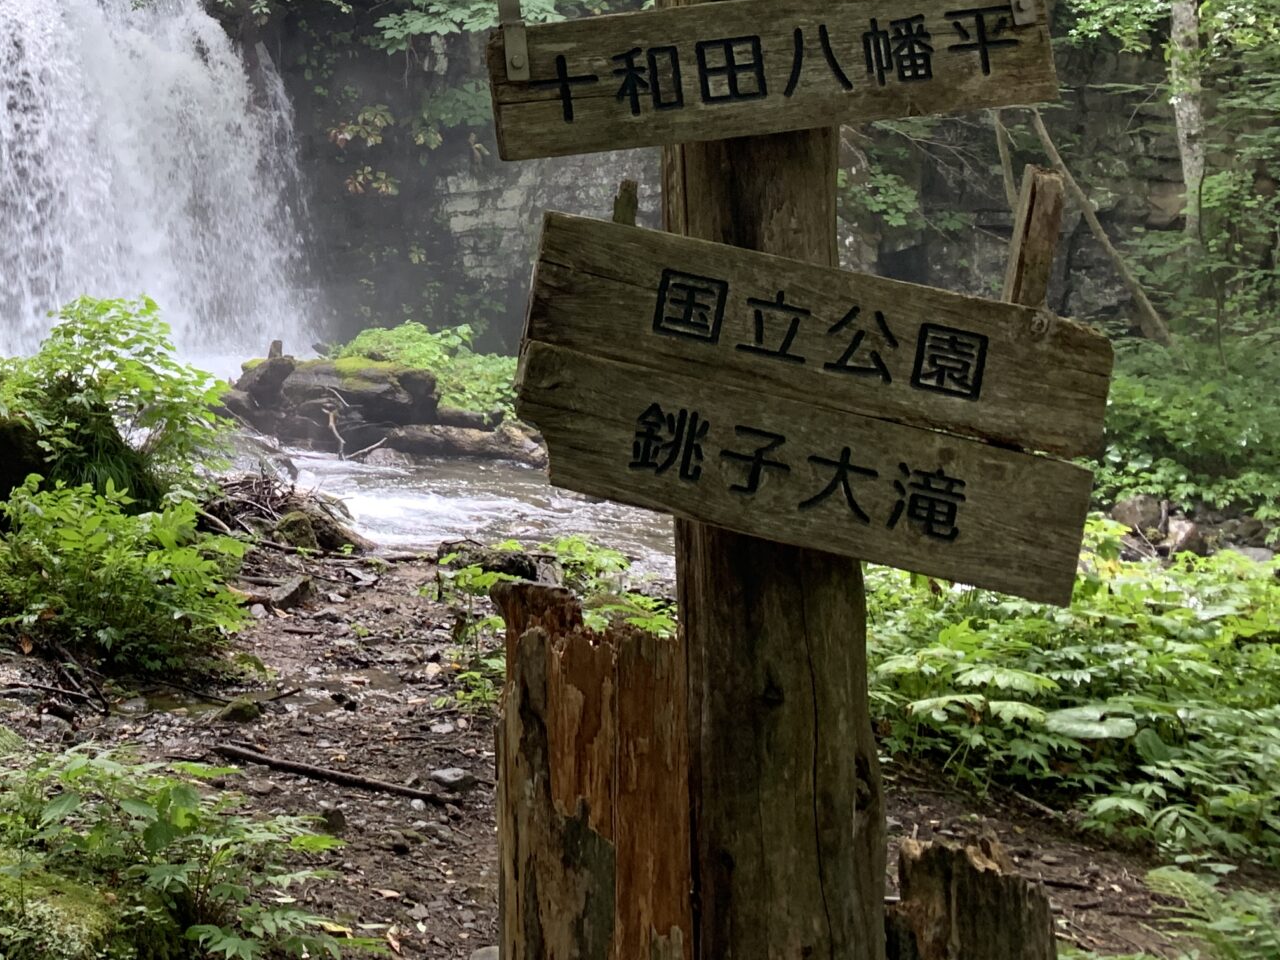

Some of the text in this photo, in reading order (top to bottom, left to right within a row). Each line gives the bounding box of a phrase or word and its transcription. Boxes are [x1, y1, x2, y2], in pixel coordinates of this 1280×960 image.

[527, 4, 1020, 124] 十和田八幡平
[651, 267, 990, 401] 国立公園
[628, 401, 967, 541] 銚子大滝
